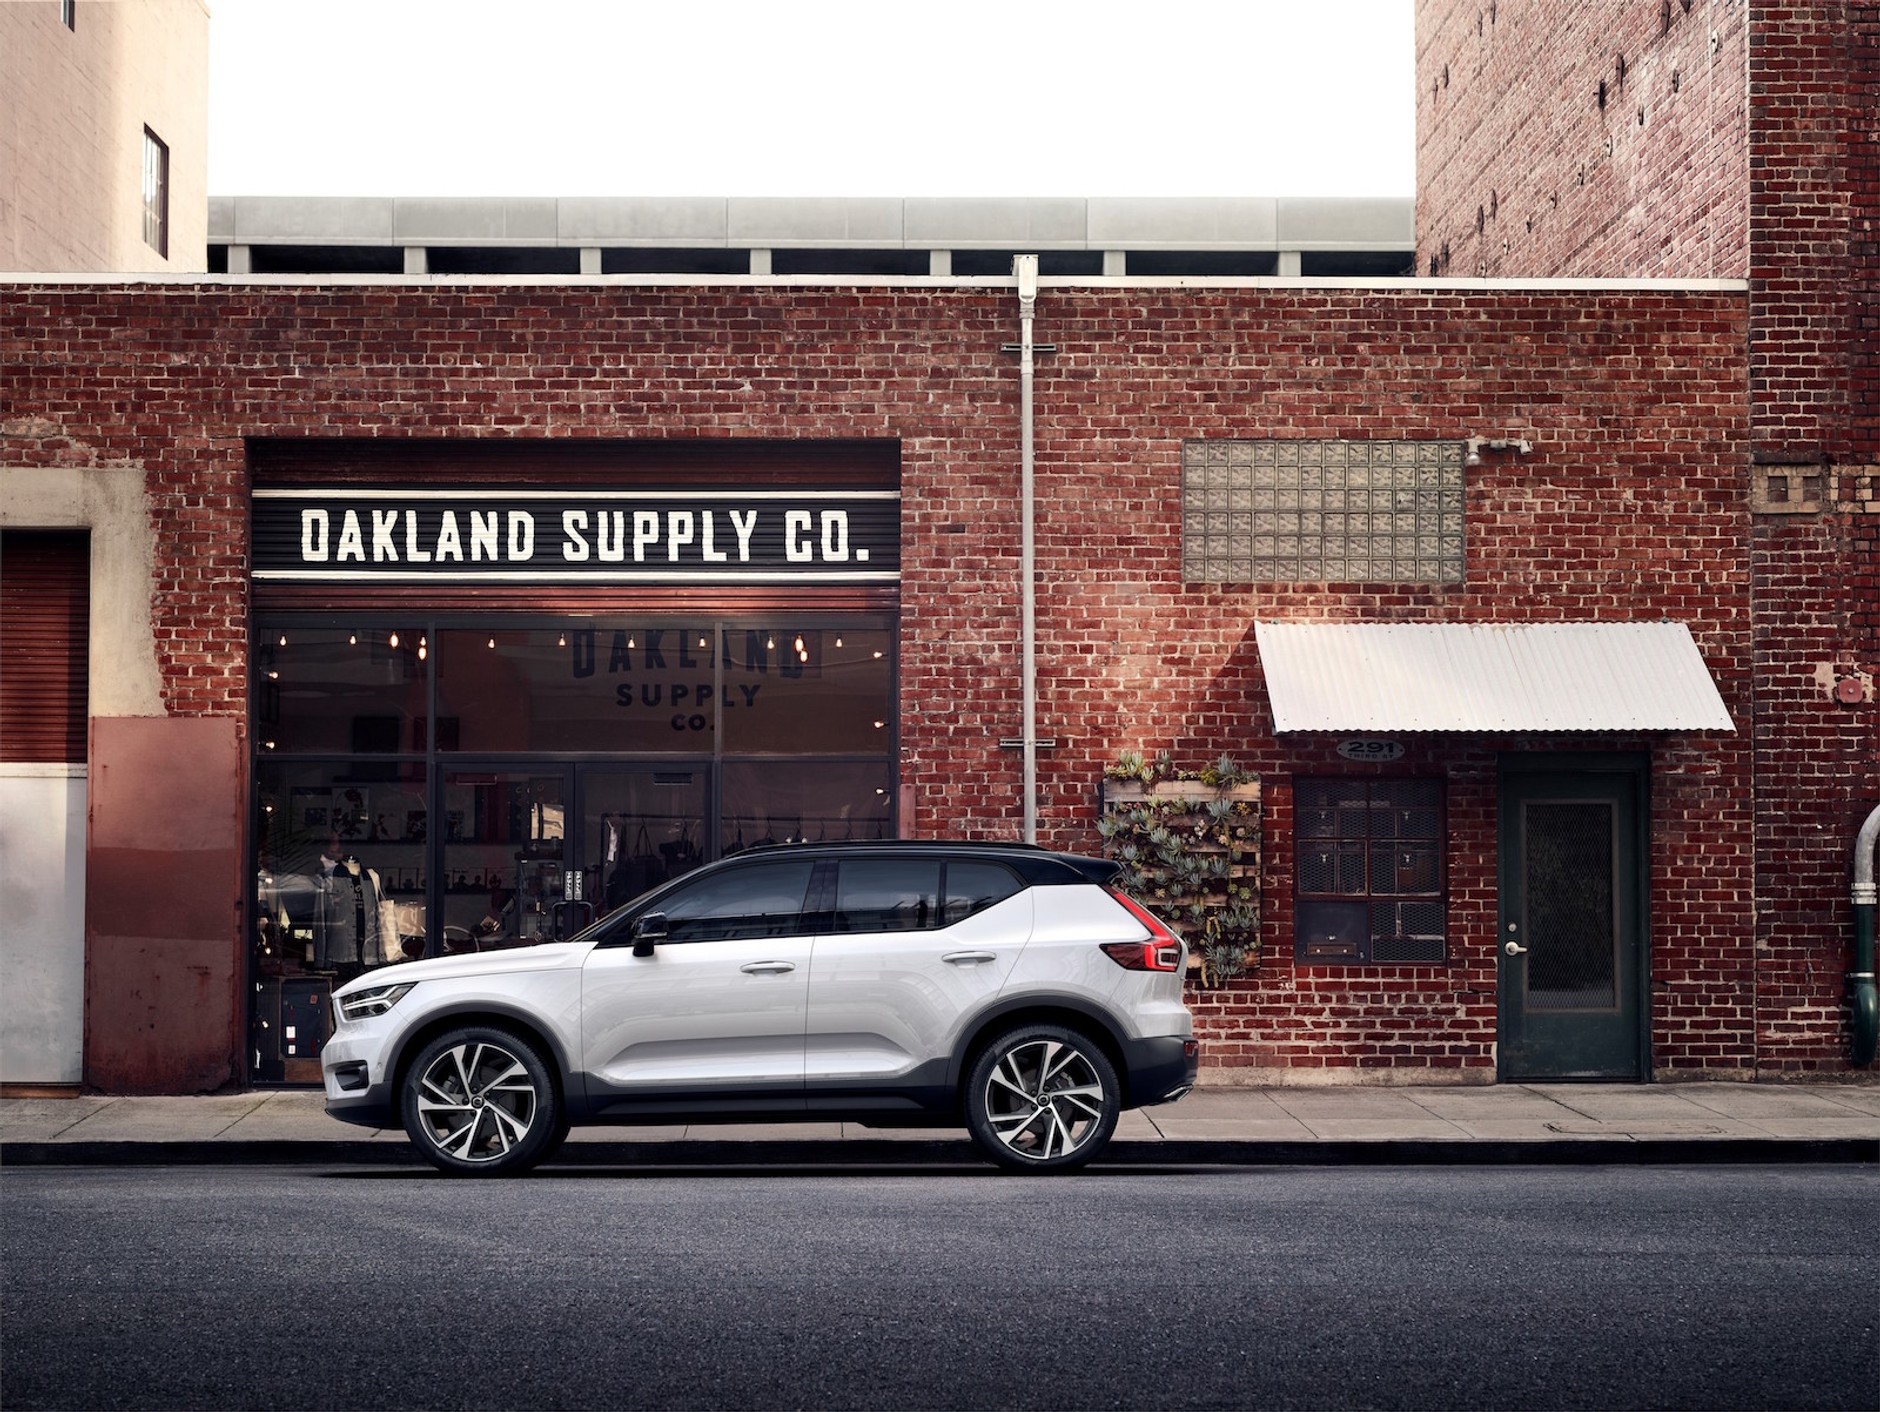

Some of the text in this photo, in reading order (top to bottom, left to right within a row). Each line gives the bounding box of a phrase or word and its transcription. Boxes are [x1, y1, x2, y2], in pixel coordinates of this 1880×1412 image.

[301, 509, 869, 562] OAKLAND SUPPLY CO.
[616, 683, 761, 707] SUPPLY
[671, 713, 715, 731] CO.
[1347, 741, 1394, 753] 291
